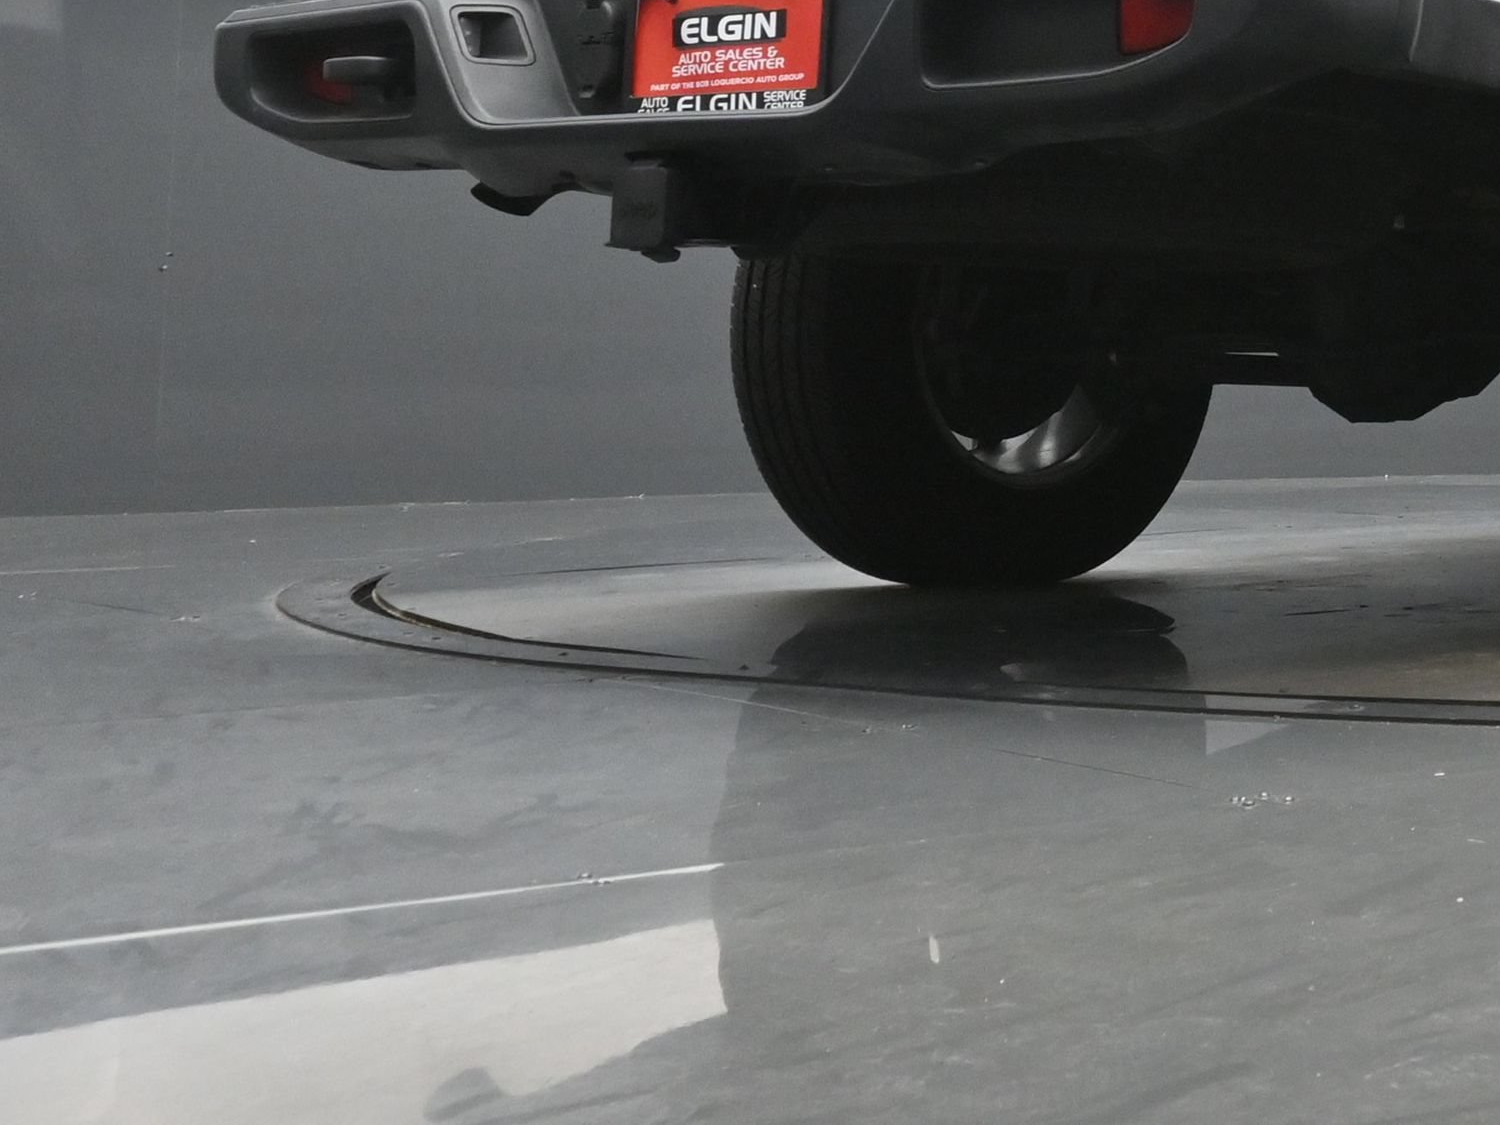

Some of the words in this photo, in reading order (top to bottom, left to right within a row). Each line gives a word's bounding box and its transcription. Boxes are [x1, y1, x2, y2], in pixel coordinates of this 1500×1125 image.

[680, 11, 777, 45] ELGIN
[678, 50, 711, 65] AUTO
[715, 47, 763, 61] SALES
[767, 46, 778, 59] &
[672, 60, 724, 77] SERVICE
[728, 57, 785, 72] CENTER
[650, 83, 670, 92] PART
[670, 82, 682, 90] OF
[682, 81, 694, 89] THE
[755, 75, 777, 84] AUTO
[778, 73, 805, 82] GROUP
[640, 96, 669, 109] AUTO
[763, 89, 807, 102] SERVICE
